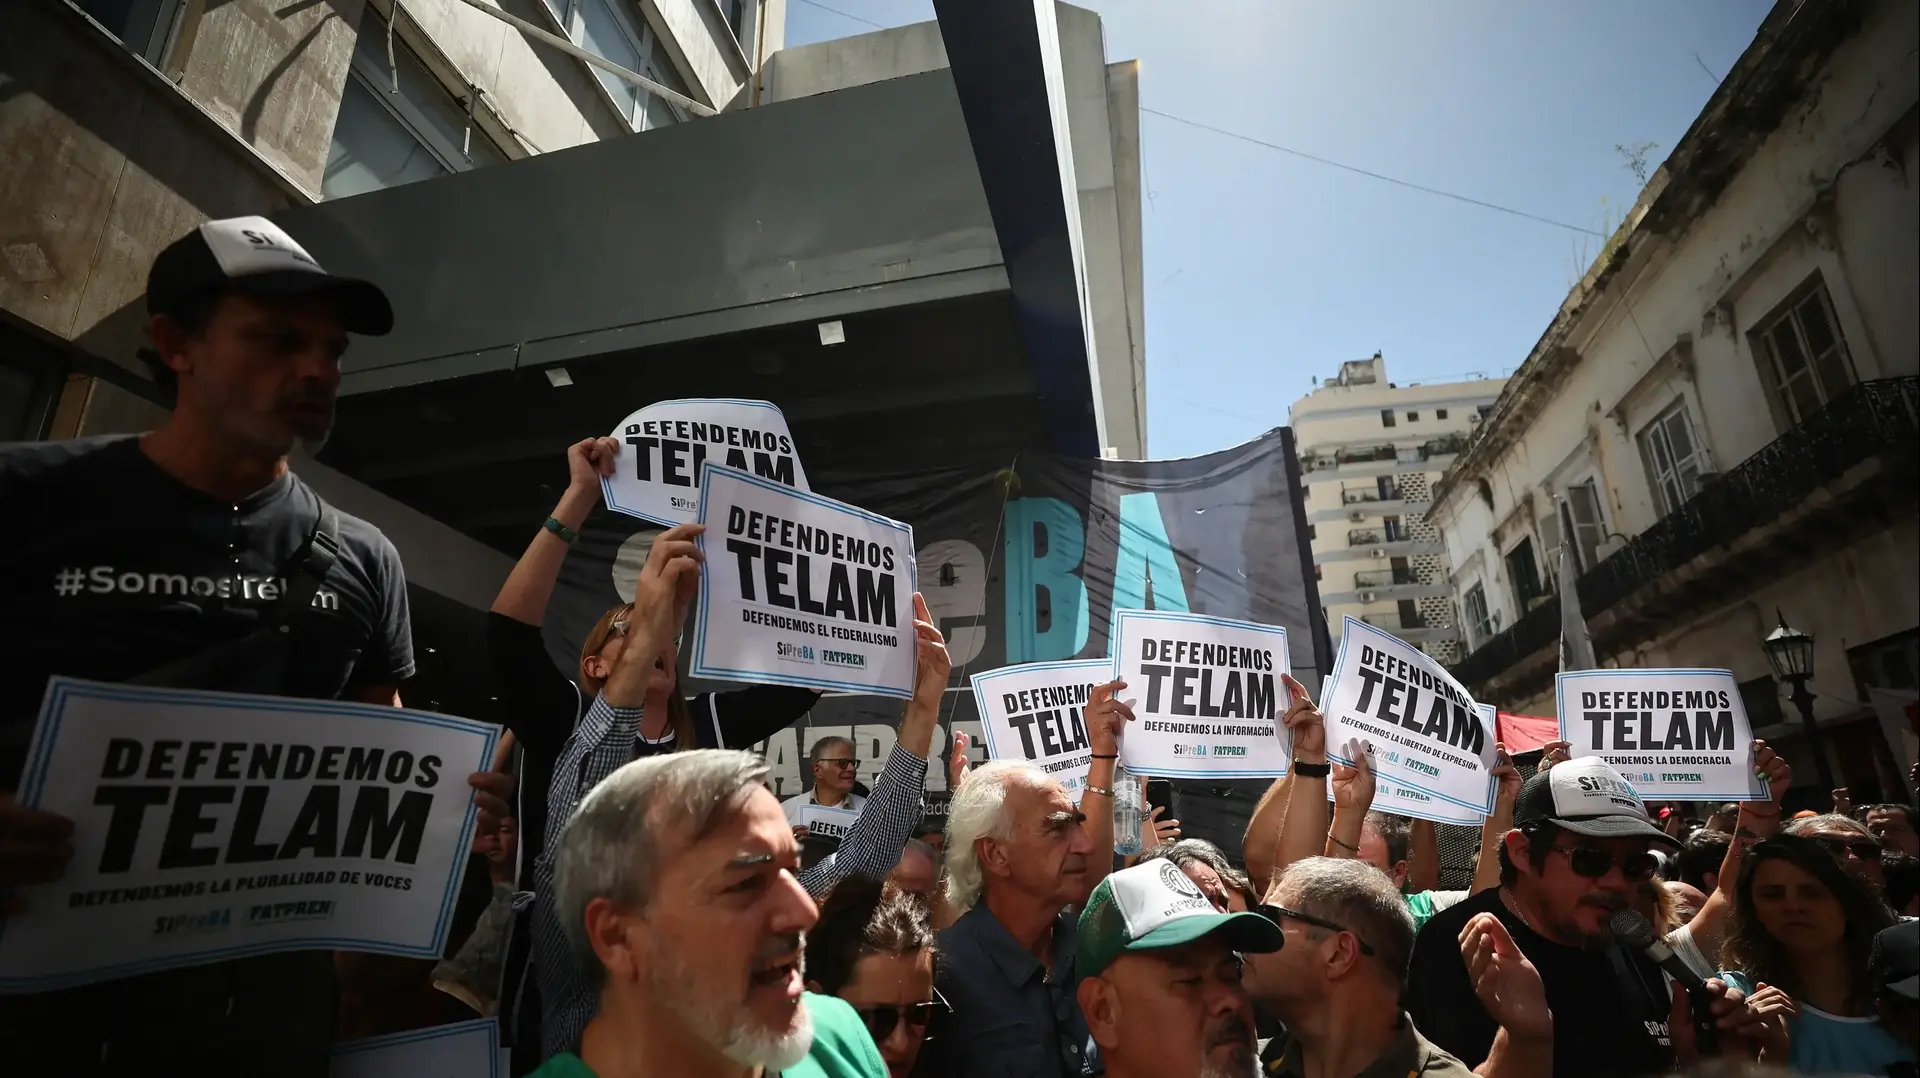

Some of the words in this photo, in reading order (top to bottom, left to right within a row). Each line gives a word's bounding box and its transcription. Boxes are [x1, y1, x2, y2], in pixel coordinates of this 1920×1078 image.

[625, 421, 792, 454] DEFENDEMOS
[671, 497, 697, 509] SiPre
[728, 505, 894, 571] DEFENDEMOS
[54, 566, 339, 610] #SomosTélm
[726, 538, 896, 628] TELAM
[742, 609, 815, 635] DEFENDEMOS
[818, 624, 829, 637] EL
[832, 626, 898, 648] FEDERALISMO
[777, 642, 814, 660] SiPreBA
[823, 650, 864, 666] FATPREN
[1141, 638, 1272, 671] DEFENDEMOS
[1141, 664, 1276, 720] TELAM
[1361, 645, 1476, 713] DEFENDEMOS
[1003, 684, 1094, 714] DEFENDEMO
[1355, 666, 1484, 756] TELAM
[1581, 690, 1730, 709] DEFENDEMOS
[1008, 706, 1092, 760] TELA
[1144, 720, 1210, 735] DEFENDEMOS
[1212, 726, 1222, 735] LA
[1223, 725, 1275, 737] INFORMACIÓN
[1340, 715, 1390, 739] DEFENDEMOS
[1391, 733, 1399, 743] LA
[1400, 738, 1432, 755] LIBERTAD
[1432, 749, 1441, 757] DE
[1442, 752, 1478, 771] EXPRESIÓN
[1583, 711, 1735, 750] TELAM
[100, 738, 442, 788] DEFENDEMOS
[1043, 759, 1074, 773] ENDEMOS
[1174, 743, 1207, 756] SiPreBA
[1213, 746, 1246, 756] FATPREN
[1367, 744, 1399, 763] SiPreBA
[1405, 758, 1440, 776] FATPREN
[1601, 755, 1654, 765] FENDEMOS
[1656, 756, 1667, 765] LA
[1669, 756, 1732, 765] DEMOCRACIA
[1661, 773, 1702, 782] FATPREN
[93, 785, 434, 874] TELAM
[810, 820, 848, 837] DEFEND
[68, 881, 206, 909] DEFENDEMOS
[210, 880, 232, 894] LA
[236, 871, 336, 891] PLURALIDAD
[339, 871, 361, 885] DE
[364, 872, 413, 891] VOCES
[250, 901, 332, 920] FATPREN
